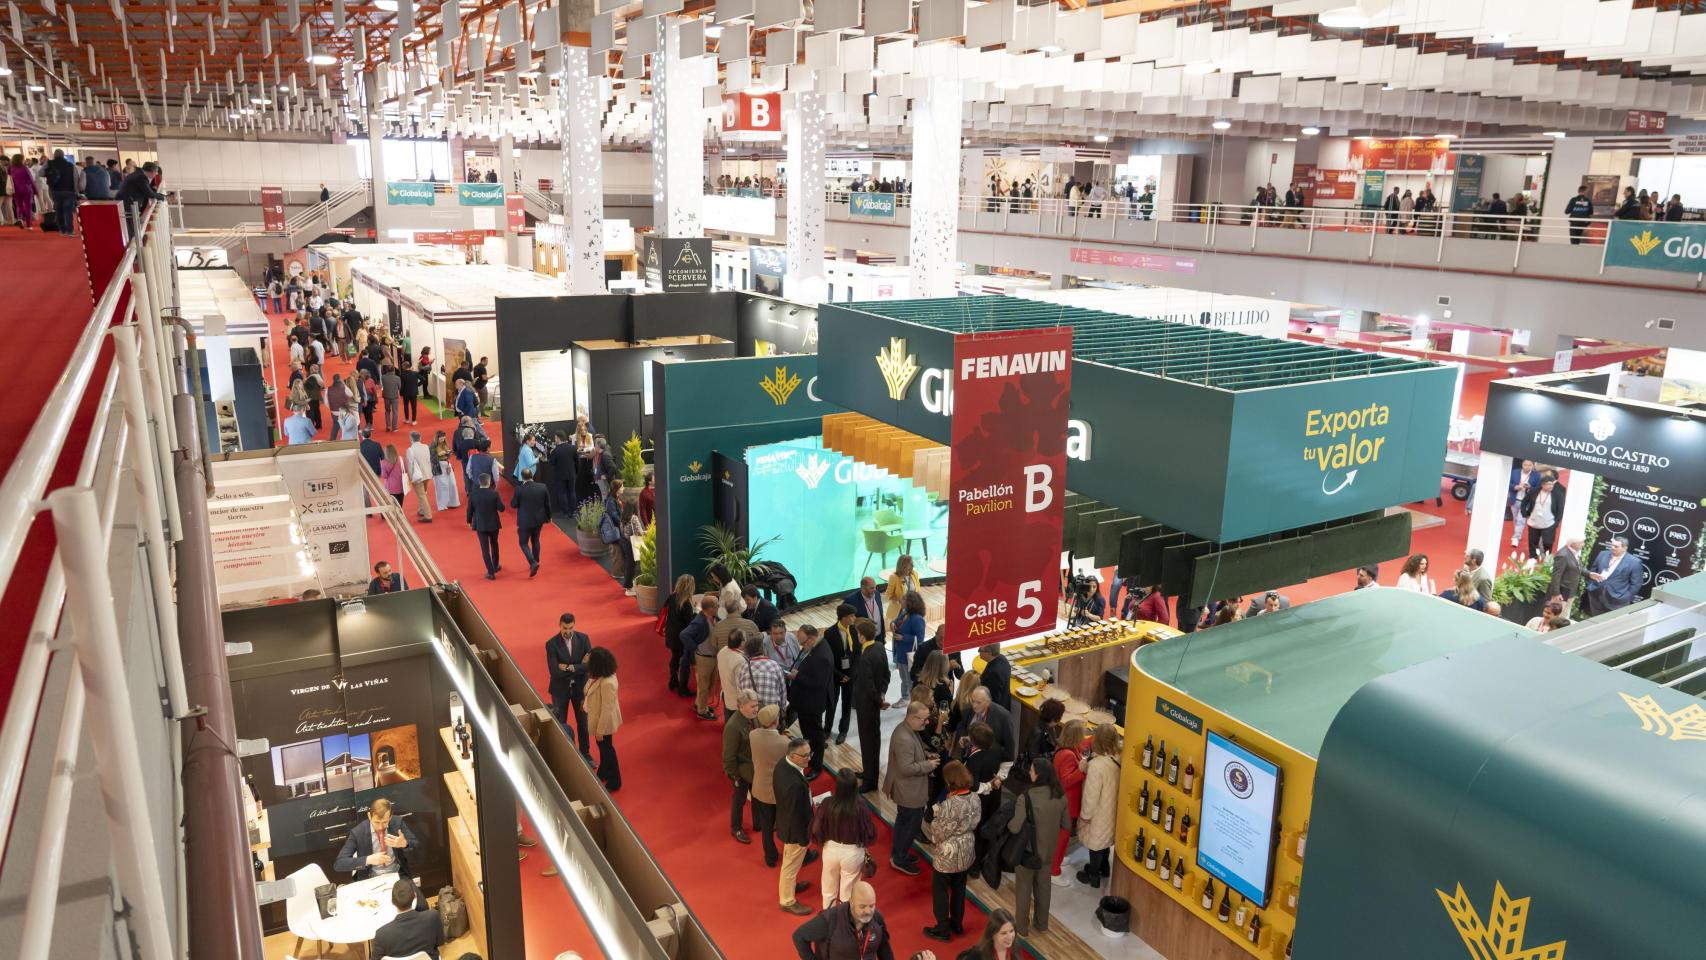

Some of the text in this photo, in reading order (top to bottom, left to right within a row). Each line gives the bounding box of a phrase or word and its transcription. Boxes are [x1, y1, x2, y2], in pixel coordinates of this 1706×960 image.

[751, 97, 770, 127] B
[400, 189, 432, 199] Globalcaja
[1214, 308, 1270, 326] BELLIDO
[961, 350, 1067, 381] FENAVIN
[1306, 402, 1389, 438] Exporta
[1304, 433, 1385, 471] tu valor
[1533, 431, 1670, 468] FERNANDO CASTRO
[1547, 446, 1650, 473] FAMILY WINERIES SINCE 1850
[317, 482, 334, 491] IFS
[958, 463, 1053, 514] Pabellón B
[1610, 485, 1697, 510] FERNANDO CASTRO
[316, 499, 344, 508] CAMPO
[965, 498, 1013, 516] Pavilion
[964, 579, 1043, 628] Calle 5
[967, 616, 1007, 638] Aisle
[290, 685, 319, 696] VIRGEN
[350, 682, 363, 690] LAS
[364, 677, 389, 687] VIÑAS
[1169, 709, 1198, 729] Globalcaja
